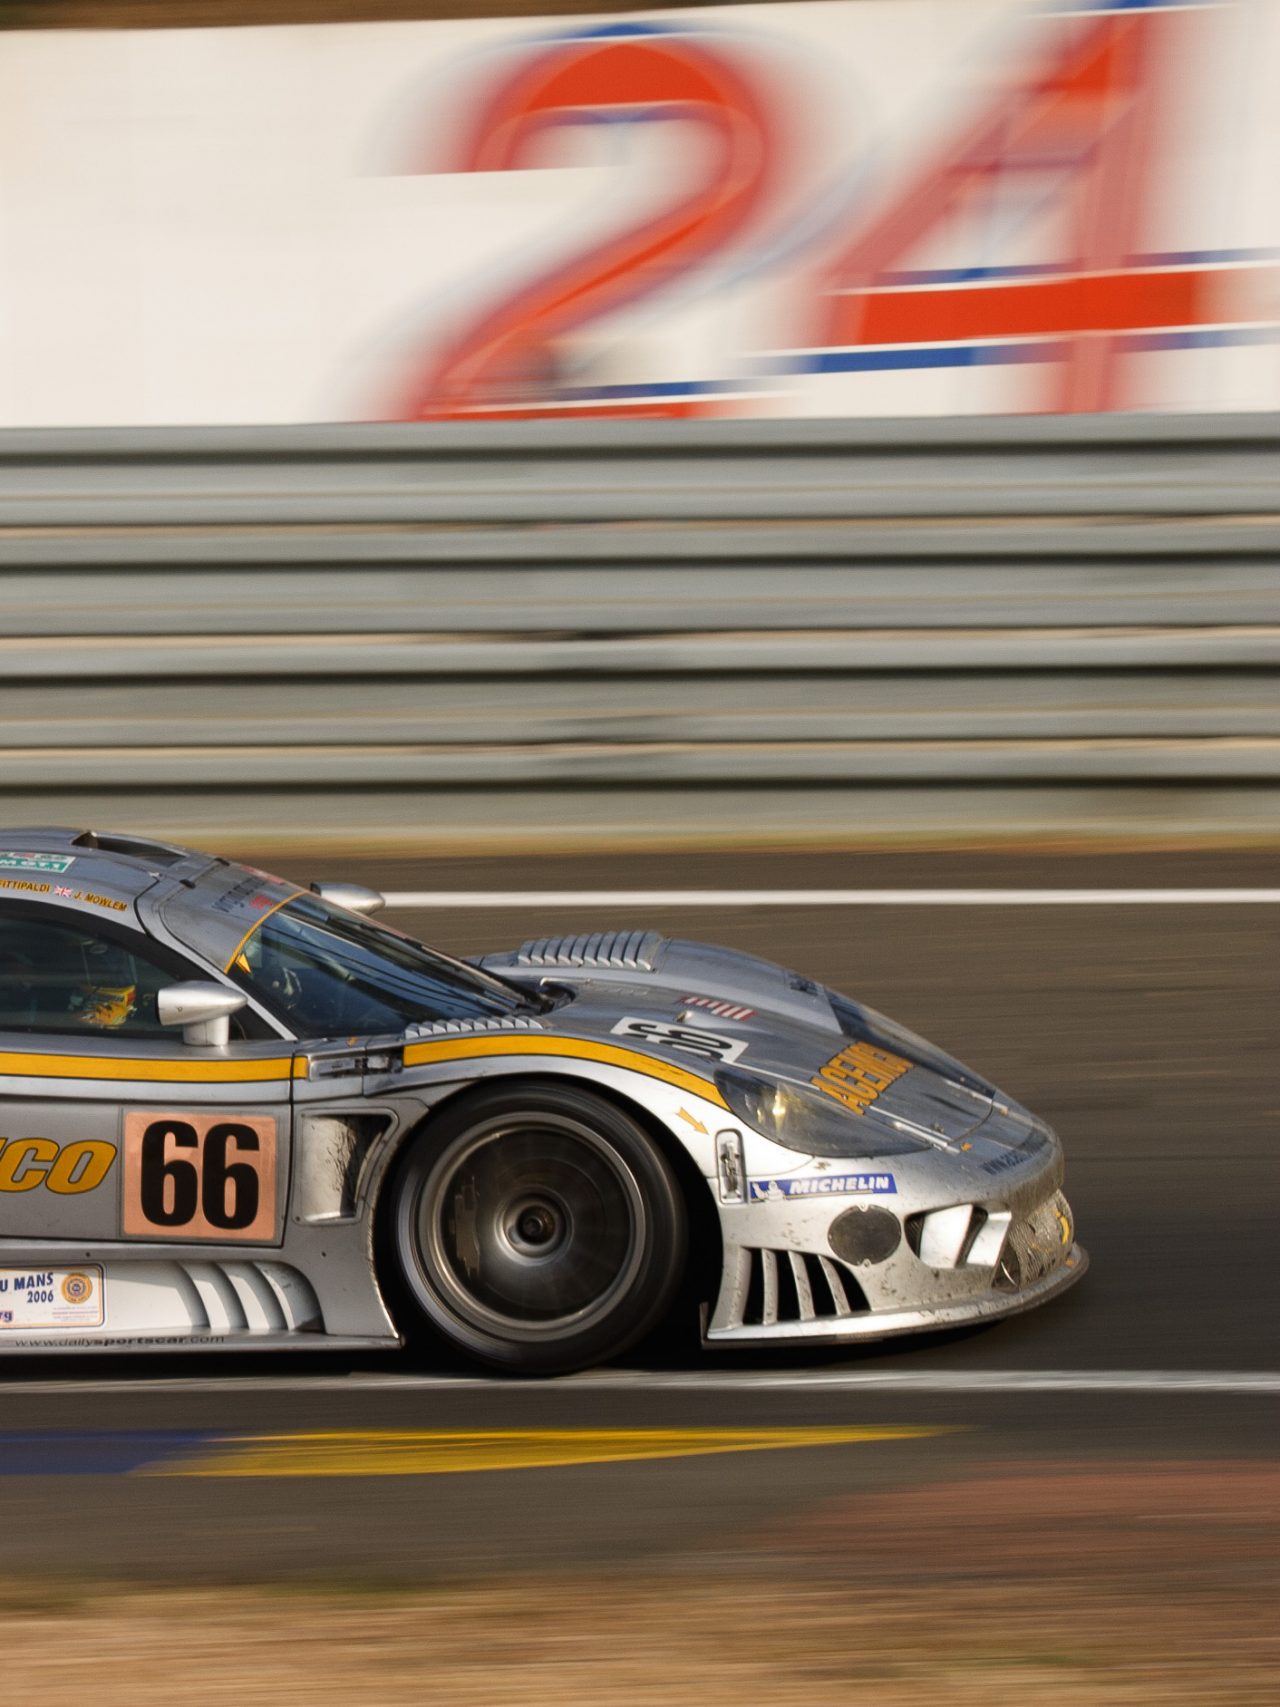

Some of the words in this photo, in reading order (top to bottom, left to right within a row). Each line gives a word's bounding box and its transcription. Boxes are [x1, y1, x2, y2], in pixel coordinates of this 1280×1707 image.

[140, 1120, 260, 1230] 66
[788, 1175, 890, 1195] MICHELIN
[13, 1272, 54, 1291] MANS
[27, 1290, 55, 1304] 2006
